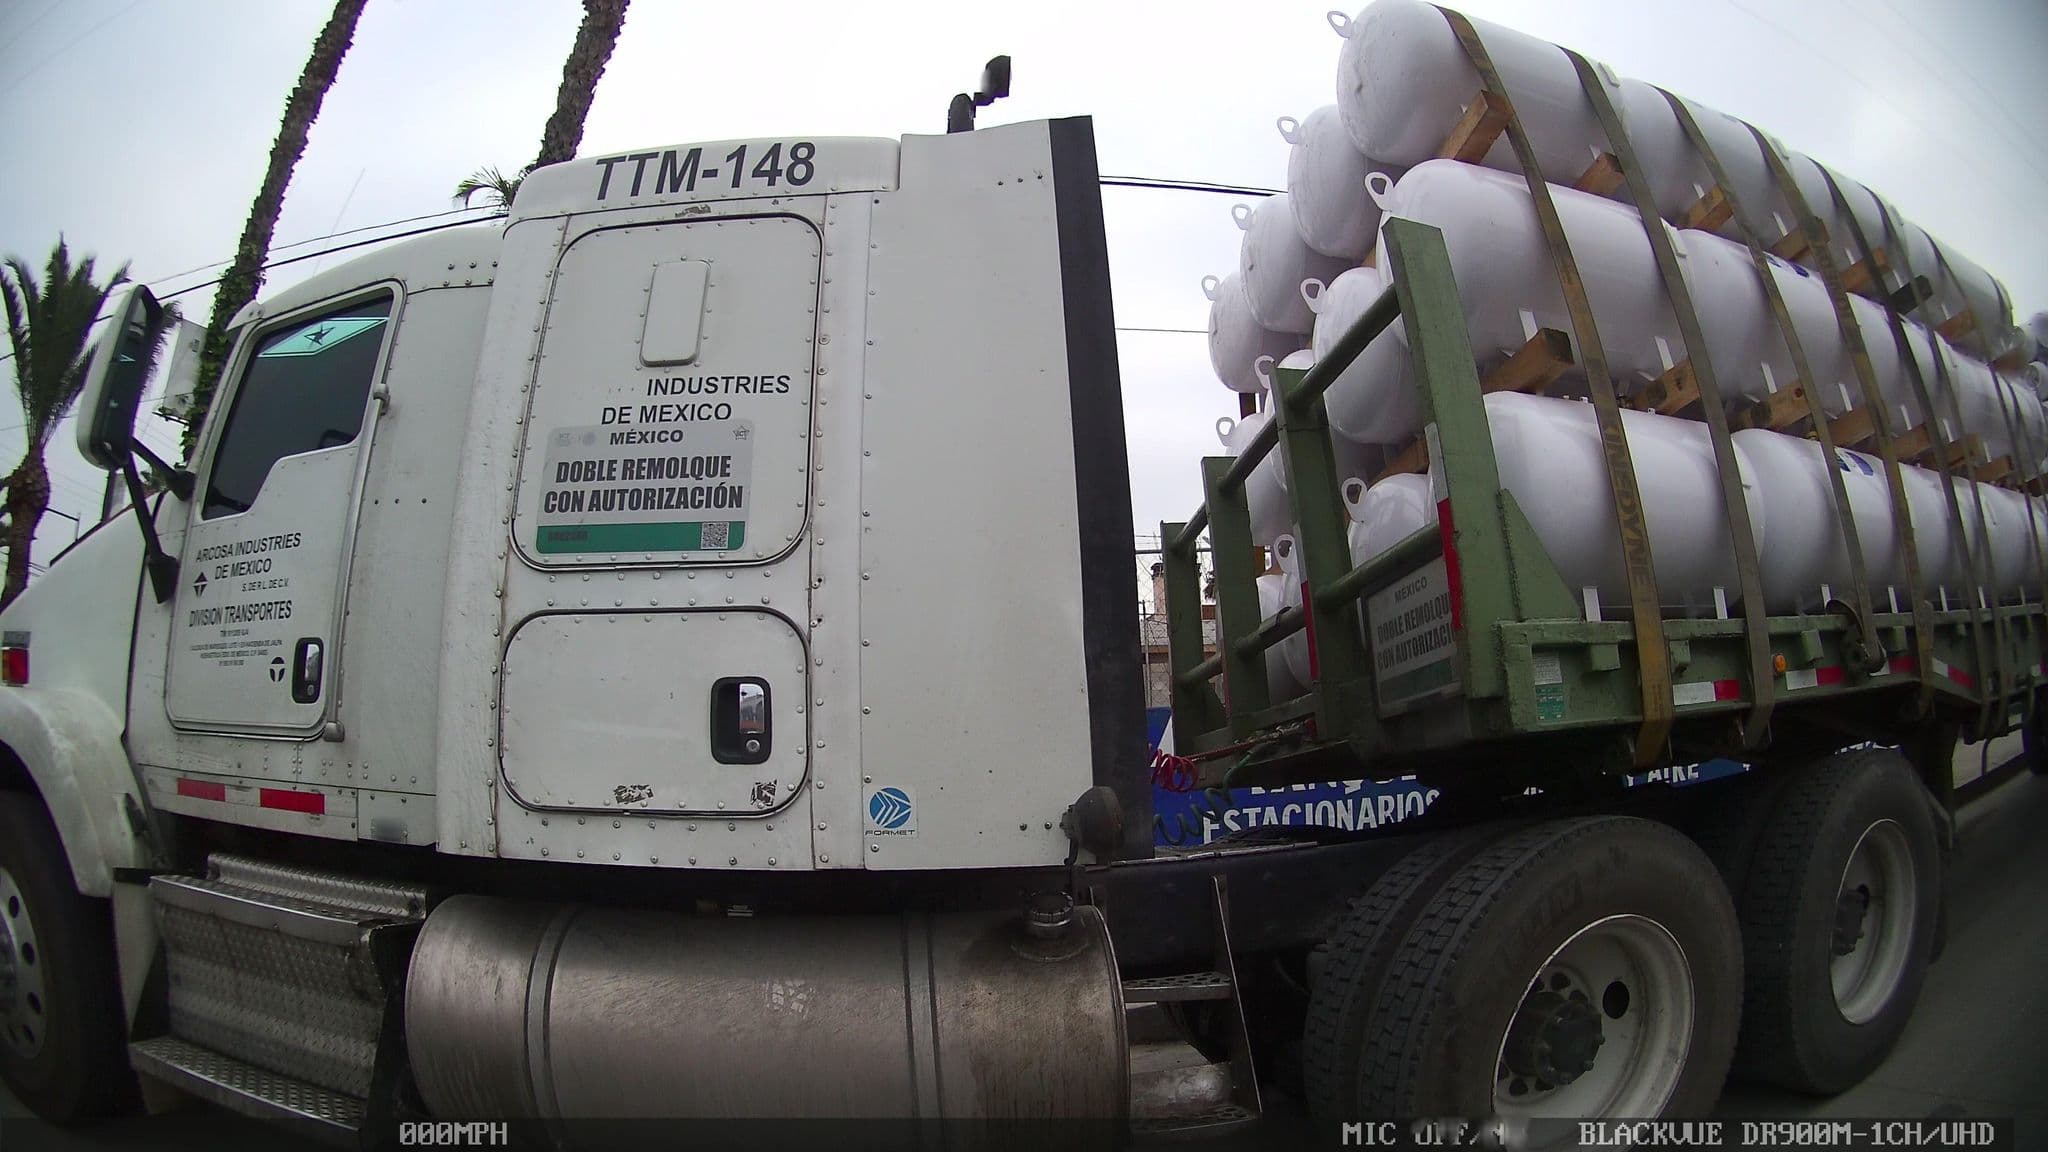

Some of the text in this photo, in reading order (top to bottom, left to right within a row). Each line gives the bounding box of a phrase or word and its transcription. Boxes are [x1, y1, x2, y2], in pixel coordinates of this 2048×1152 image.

[595, 142, 816, 200] TTM-148
[647, 375, 791, 396] INDUSTRIES
[601, 403, 732, 425] DE MEXICO
[609, 428, 684, 445] MÉXICO
[555, 455, 732, 483] DOBLE REMOLQUE
[544, 482, 743, 514] CON AUTORIZACIÓN
[196, 532, 302, 562] ARCOSA INDUSTRIES
[214, 558, 272, 580] DE MEXICO
[189, 600, 292, 628] DIVISION TRANSPORTES
[1377, 591, 1451, 644] DOBLE REMOLQU
[1377, 645, 1394, 671] CON
